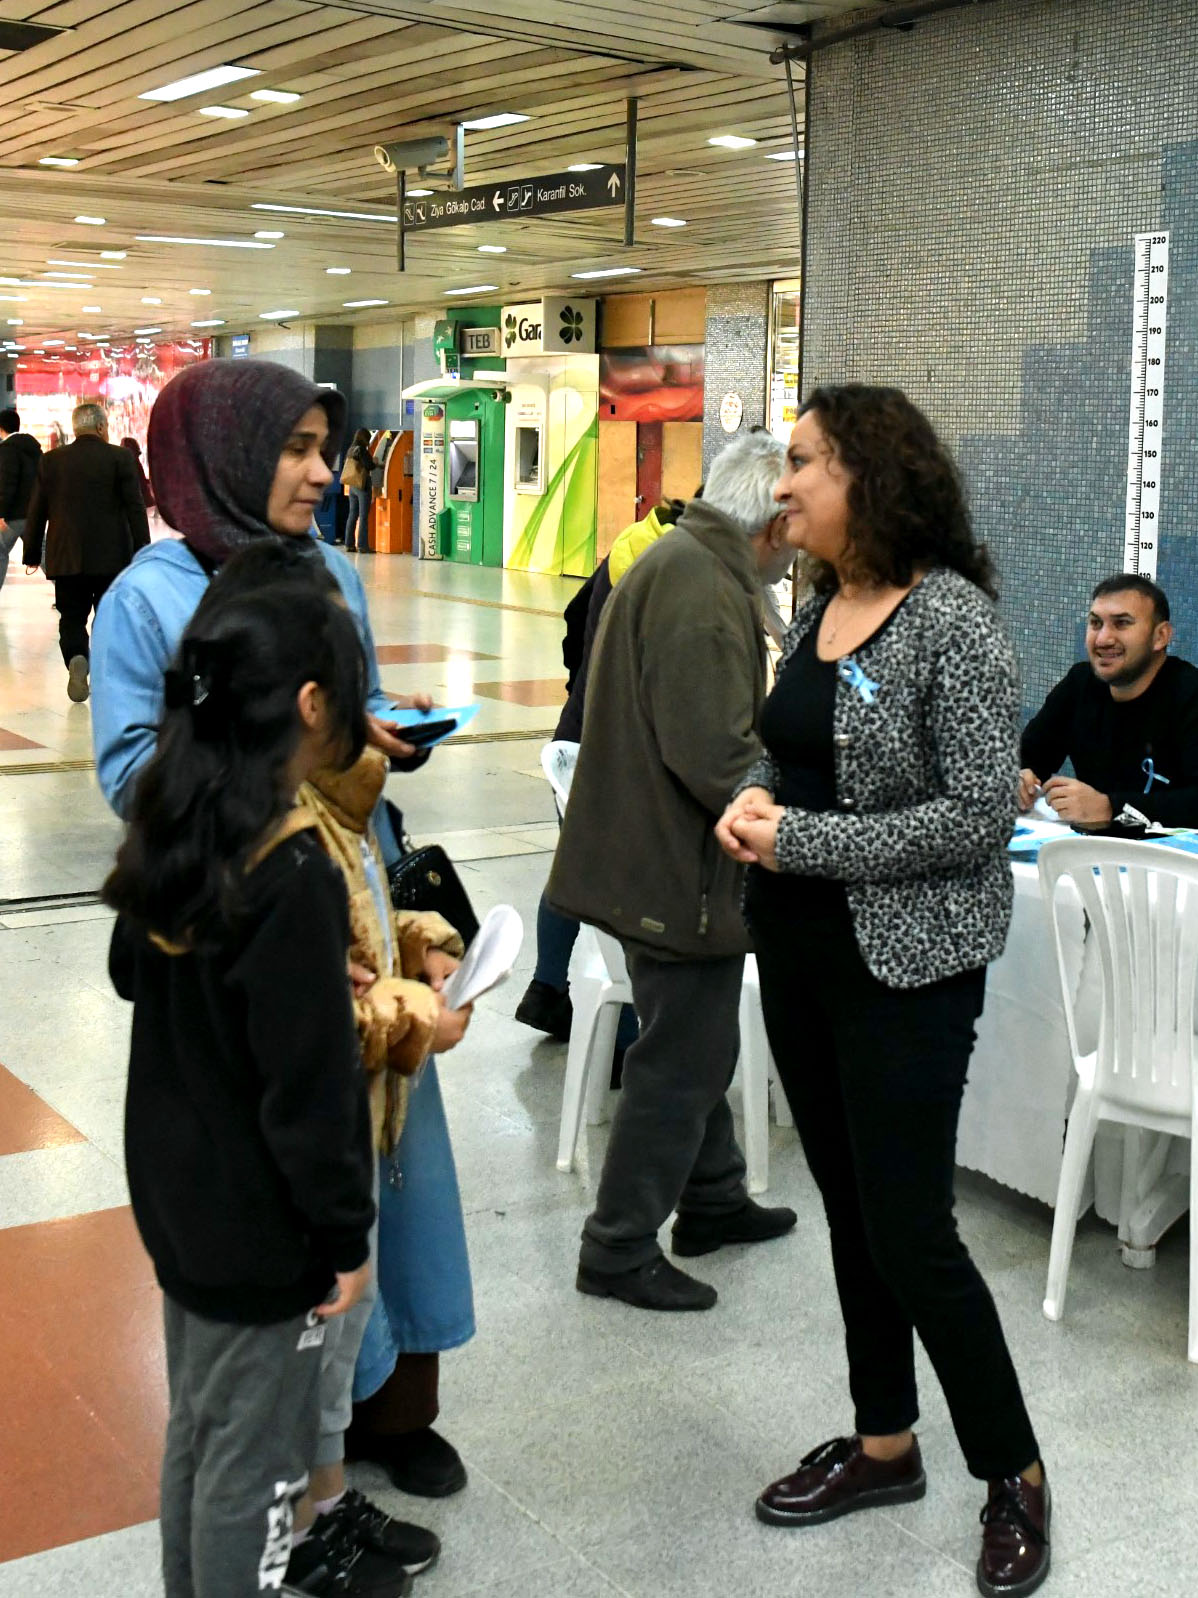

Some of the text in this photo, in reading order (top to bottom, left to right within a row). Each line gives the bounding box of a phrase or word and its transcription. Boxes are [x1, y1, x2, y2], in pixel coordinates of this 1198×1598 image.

[537, 183, 587, 202] Karanfil Sok.
[431, 204, 444, 219] Ziya
[446, 200, 469, 214] Gökalp
[1150, 296, 1164, 304] 200
[519, 318, 542, 341] Gar
[1149, 327, 1162, 335] 190
[468, 334, 490, 349] TEB
[1148, 358, 1161, 366] 180
[1144, 450, 1157, 458] 150
[430, 459, 437, 470] 24
[1143, 481, 1156, 489] 140
[428, 487, 436, 530] ADVANCE
[428, 532, 436, 557] CASH
[1140, 542, 1153, 550] 120
